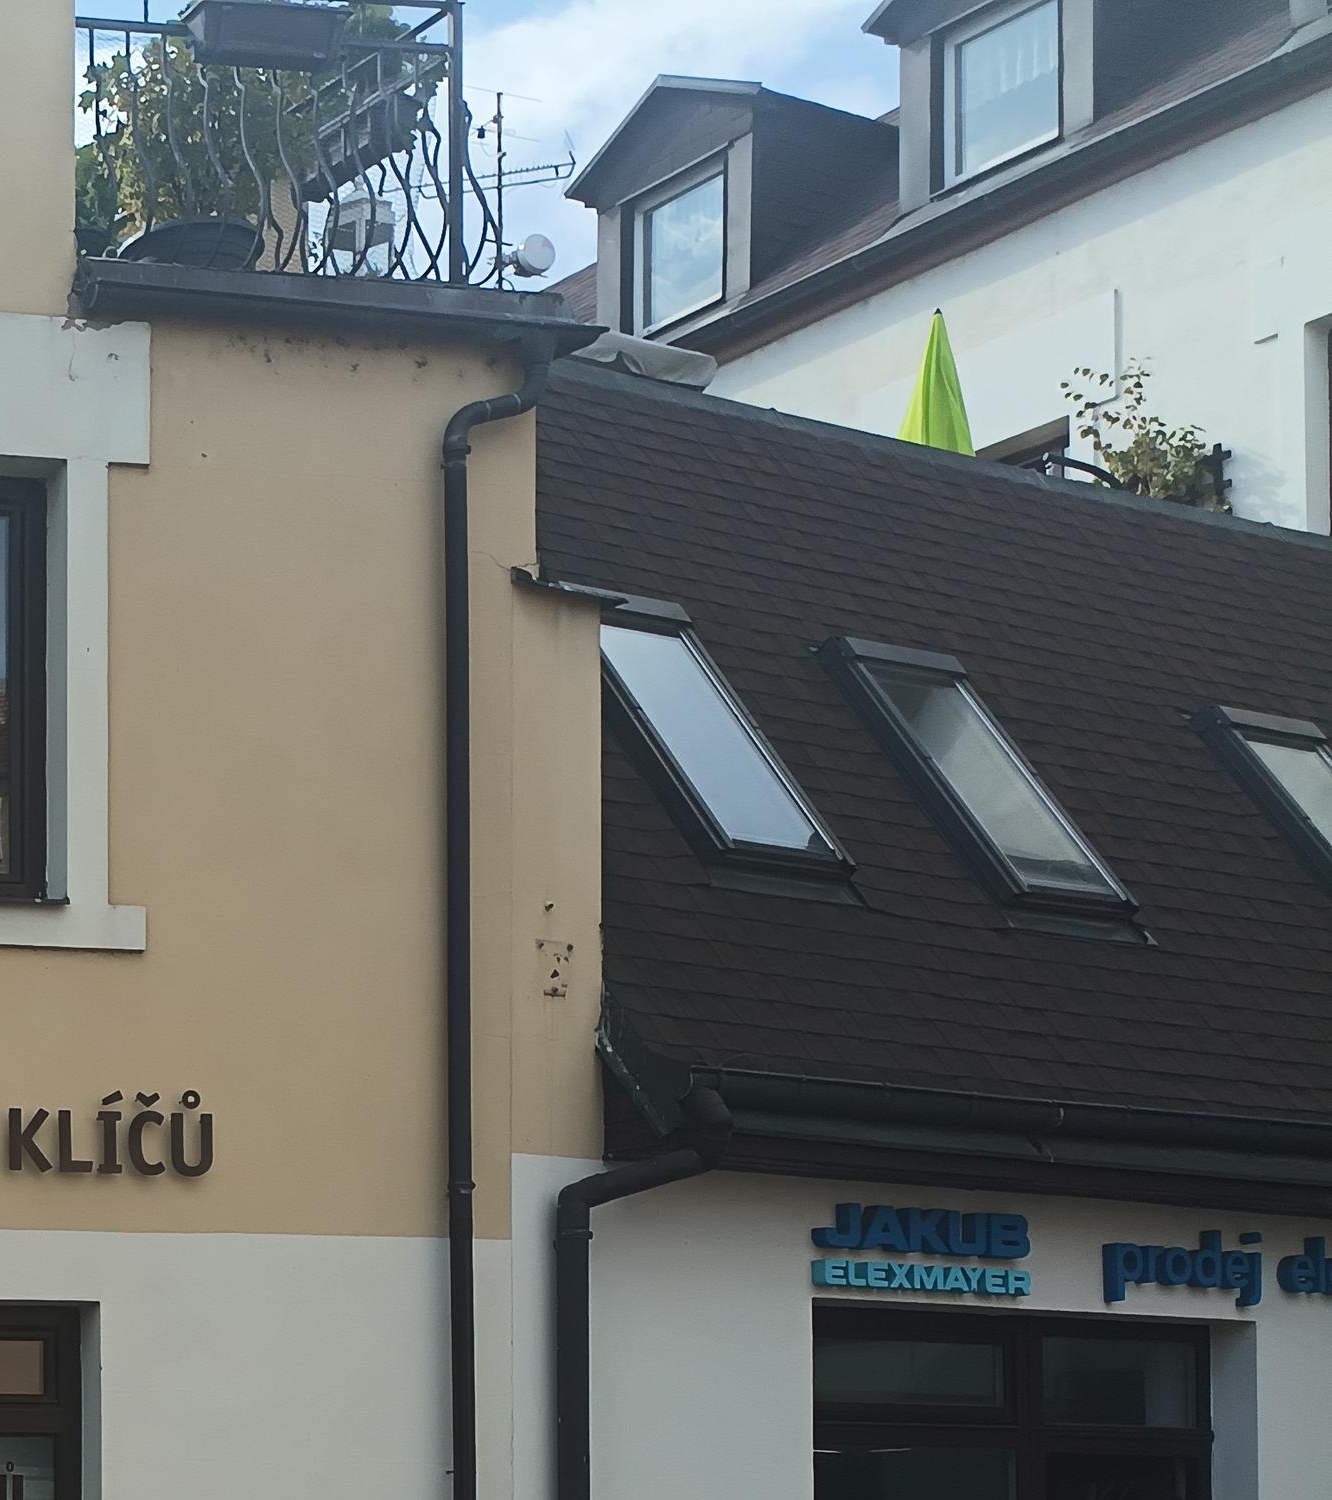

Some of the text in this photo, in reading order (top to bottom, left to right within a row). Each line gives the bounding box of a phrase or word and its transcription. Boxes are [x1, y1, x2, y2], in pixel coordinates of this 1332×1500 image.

[8, 1089, 214, 1178] KLÍČŮ
[811, 1203, 1030, 1259] JAKUB
[811, 1260, 1032, 1296] ELEXMAYER
[1102, 1230, 1332, 1307] prodej el
